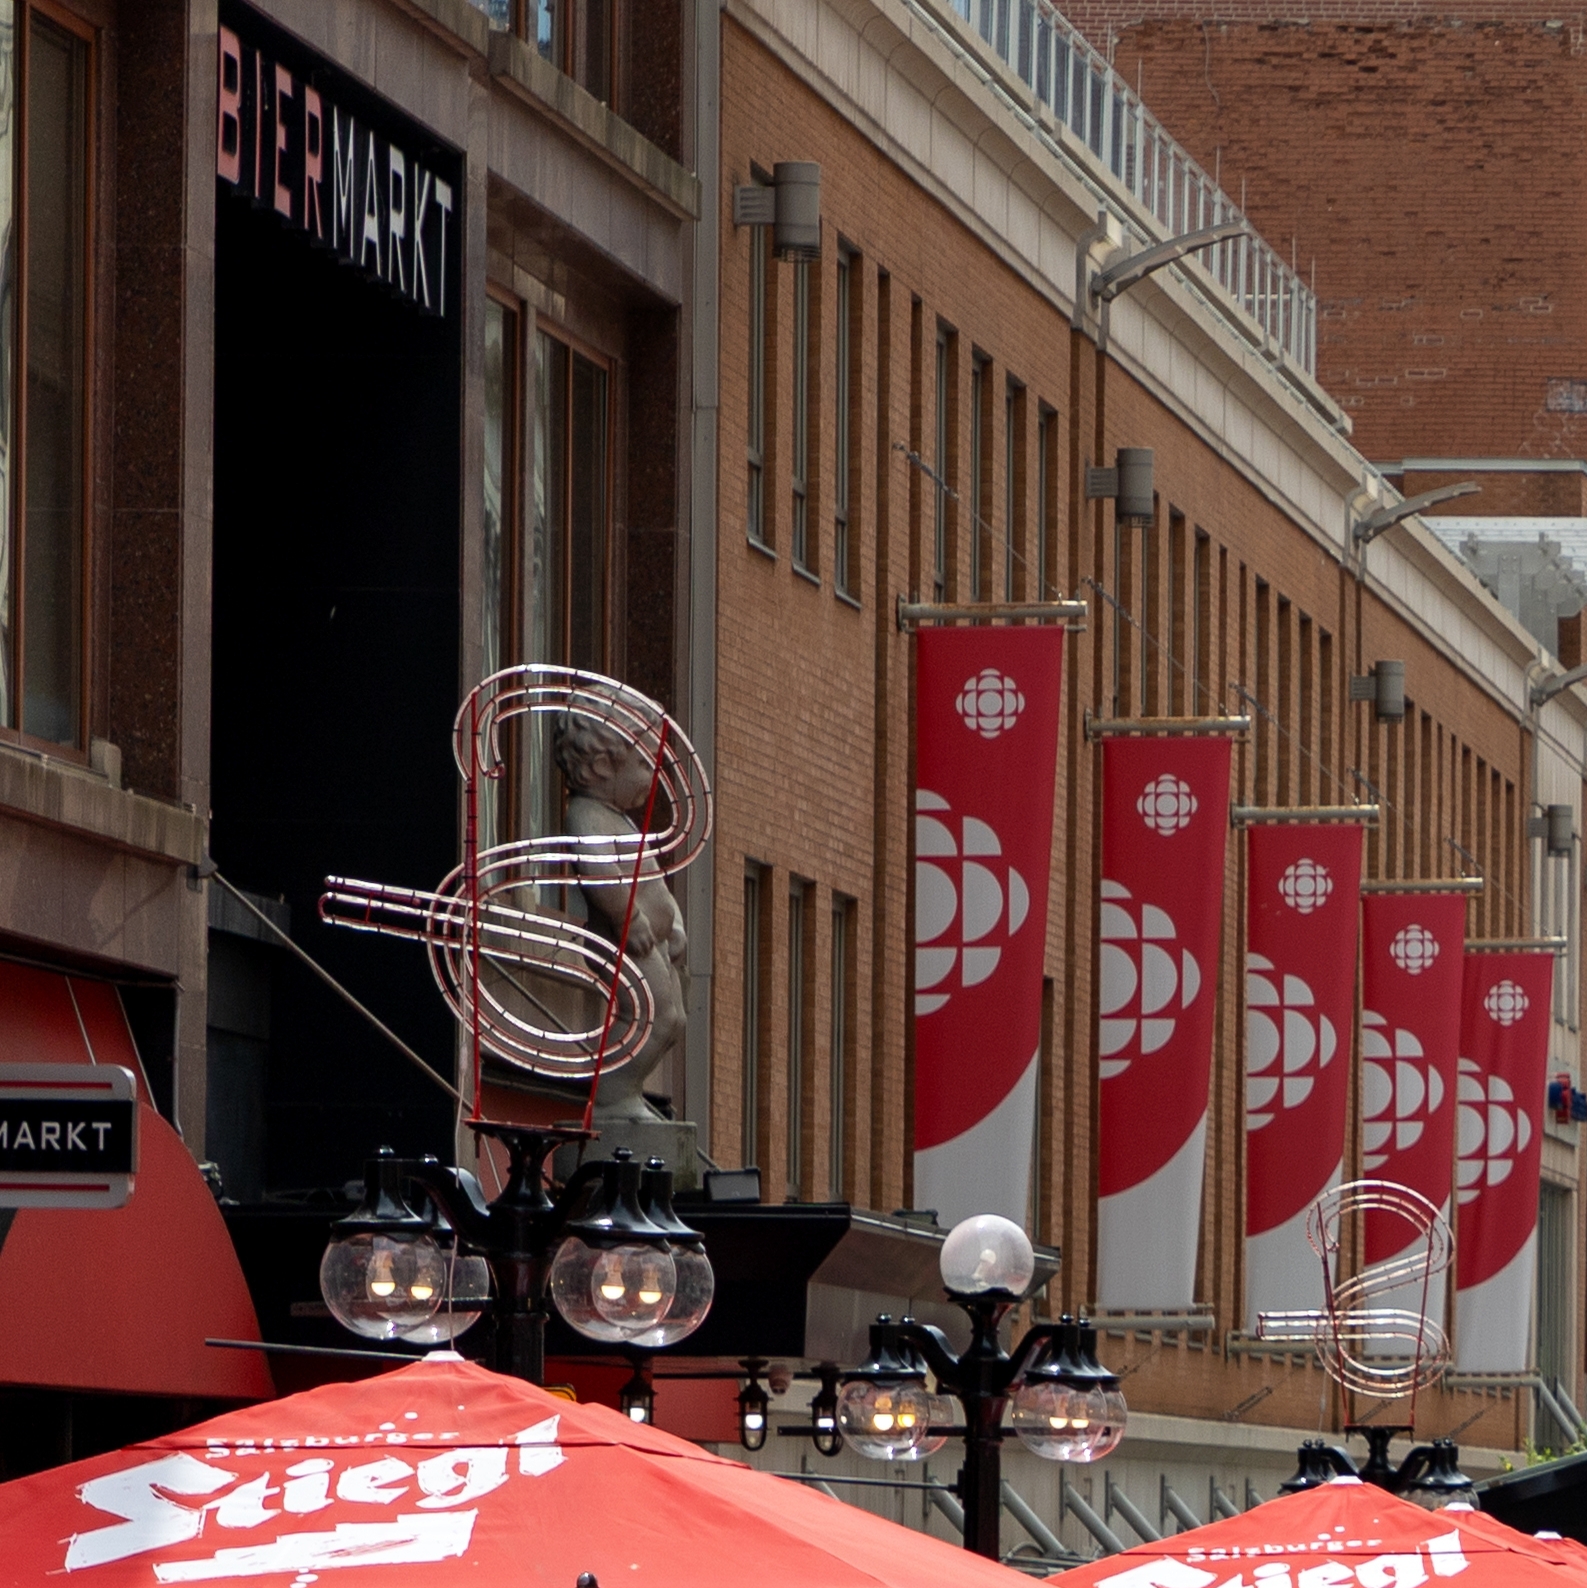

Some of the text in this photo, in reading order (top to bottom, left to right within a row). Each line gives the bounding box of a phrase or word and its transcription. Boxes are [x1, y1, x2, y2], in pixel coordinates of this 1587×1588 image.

[206, 1431, 460, 1459] Salzburger
[48, 1415, 567, 1573] Stiegl
[1187, 1539, 1382, 1562] Salzburger
